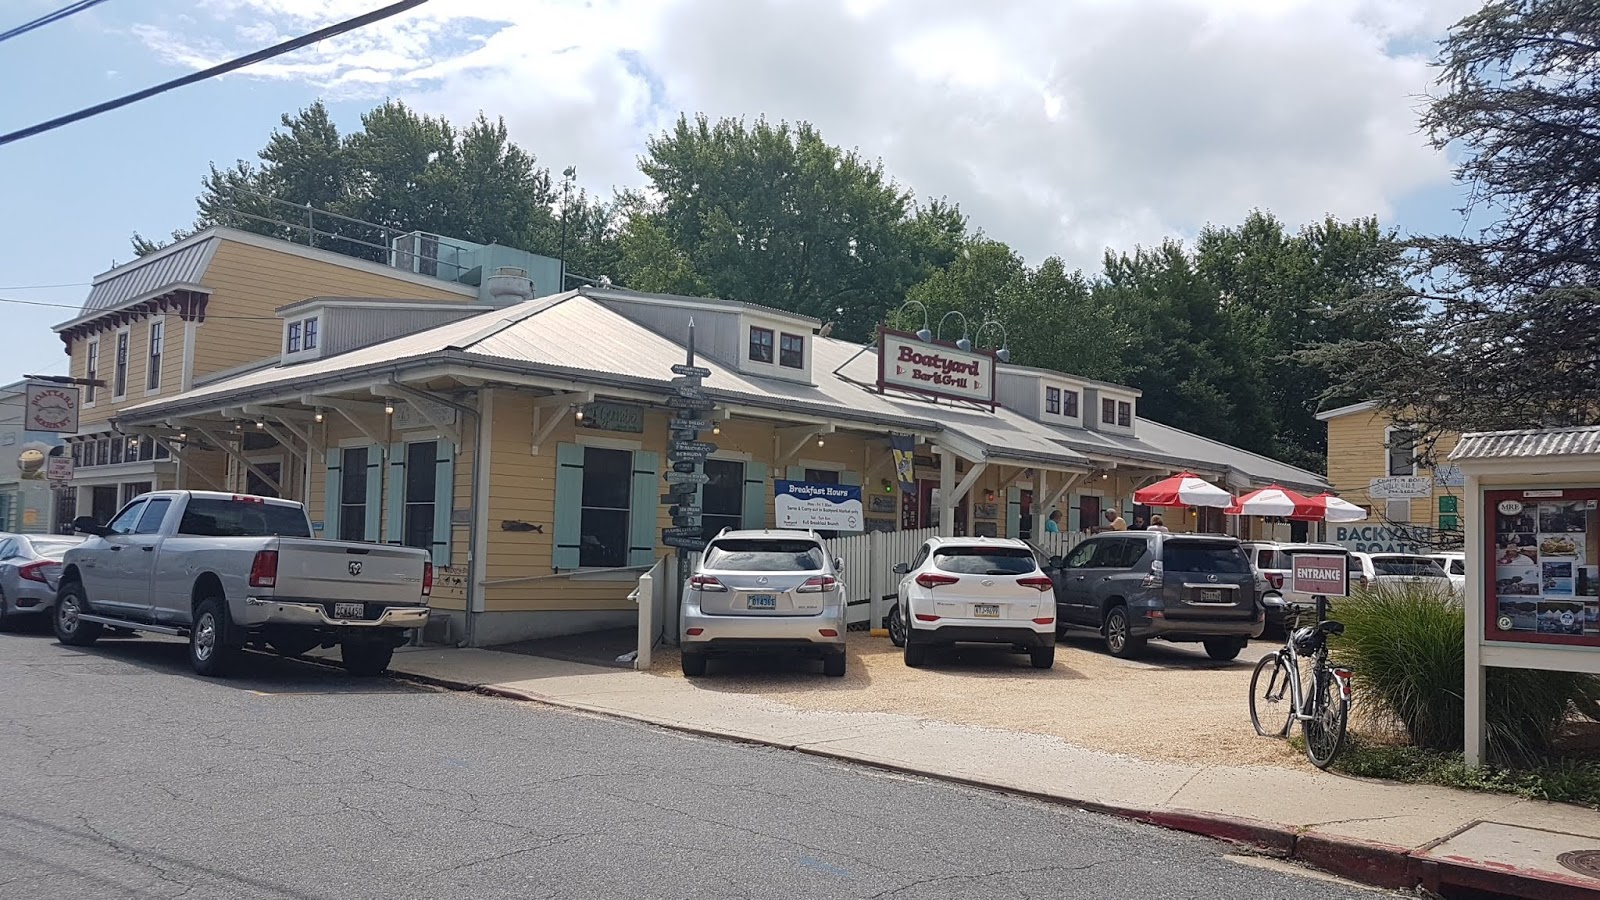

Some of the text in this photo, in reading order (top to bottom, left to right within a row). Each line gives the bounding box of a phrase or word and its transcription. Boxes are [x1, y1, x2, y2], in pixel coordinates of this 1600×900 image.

[898, 346, 979, 376] Boatyard
[912, 369, 933, 381] Bar
[941, 375, 967, 388] Grill
[31, 390, 74, 409] BOATYARD
[34, 415, 70, 428] MARKET
[789, 485, 848, 497] Breakfast Hours
[1297, 568, 1341, 581] ENTRANCE
